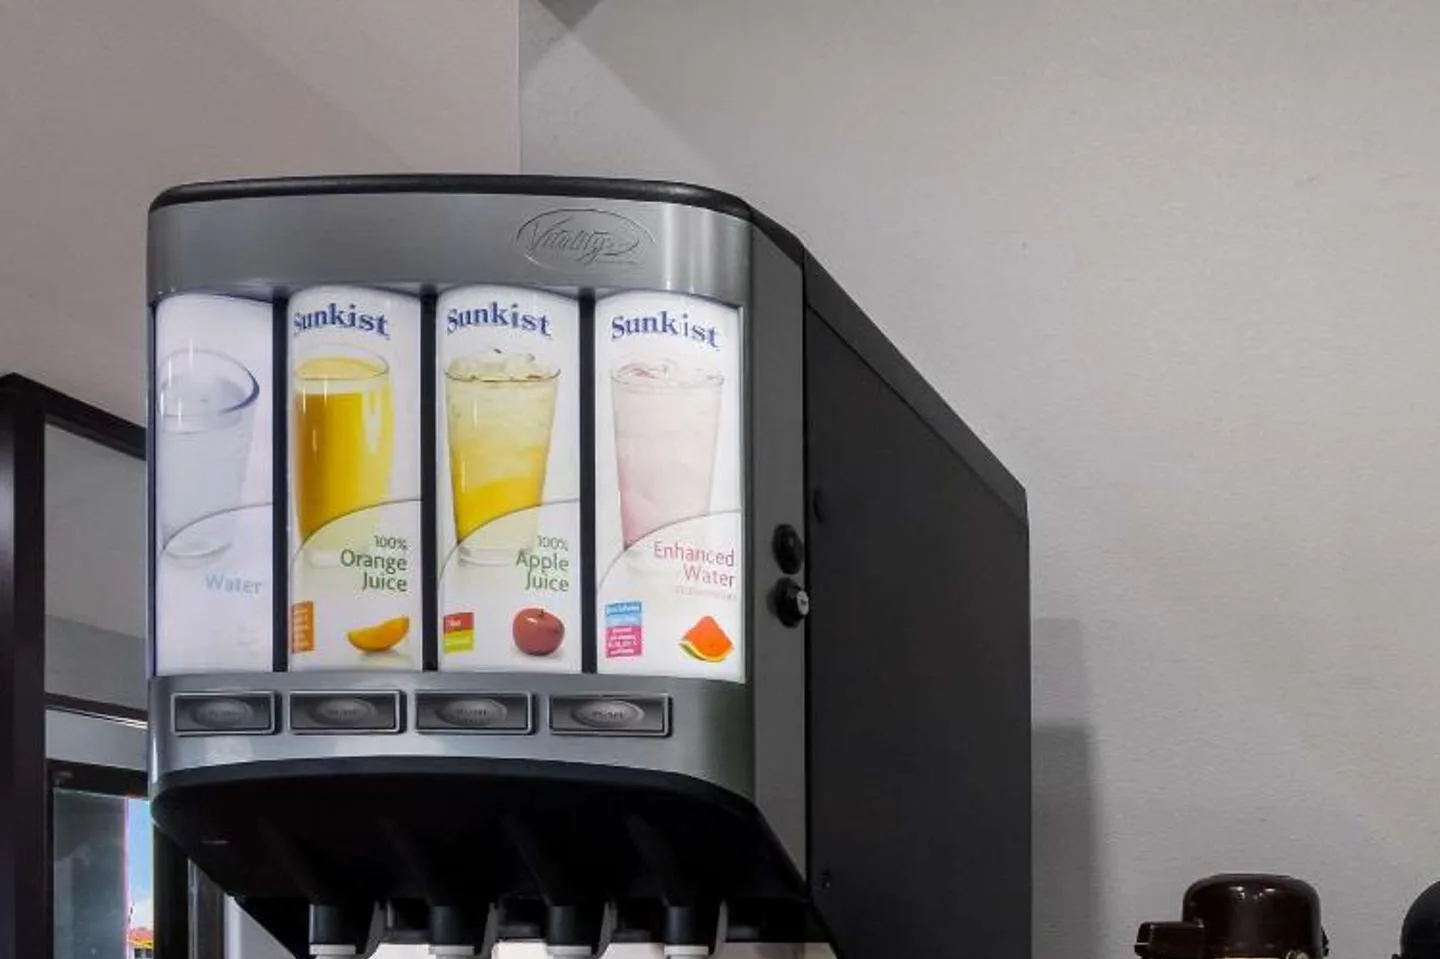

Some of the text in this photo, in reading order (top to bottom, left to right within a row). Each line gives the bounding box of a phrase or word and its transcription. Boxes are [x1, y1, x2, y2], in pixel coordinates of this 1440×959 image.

[293, 303, 392, 341] Sunkist
[447, 301, 552, 341] Sunkist
[611, 310, 720, 351] Sunkist
[374, 535, 408, 550] 100%
[537, 534, 569, 551] 100%
[653, 540, 735, 568] Enhanced
[340, 549, 408, 574] Orange
[515, 550, 569, 574] Apple
[205, 574, 262, 595] Water
[362, 572, 408, 592] Juice
[524, 571, 570, 593] Juice
[684, 564, 736, 588] Water
